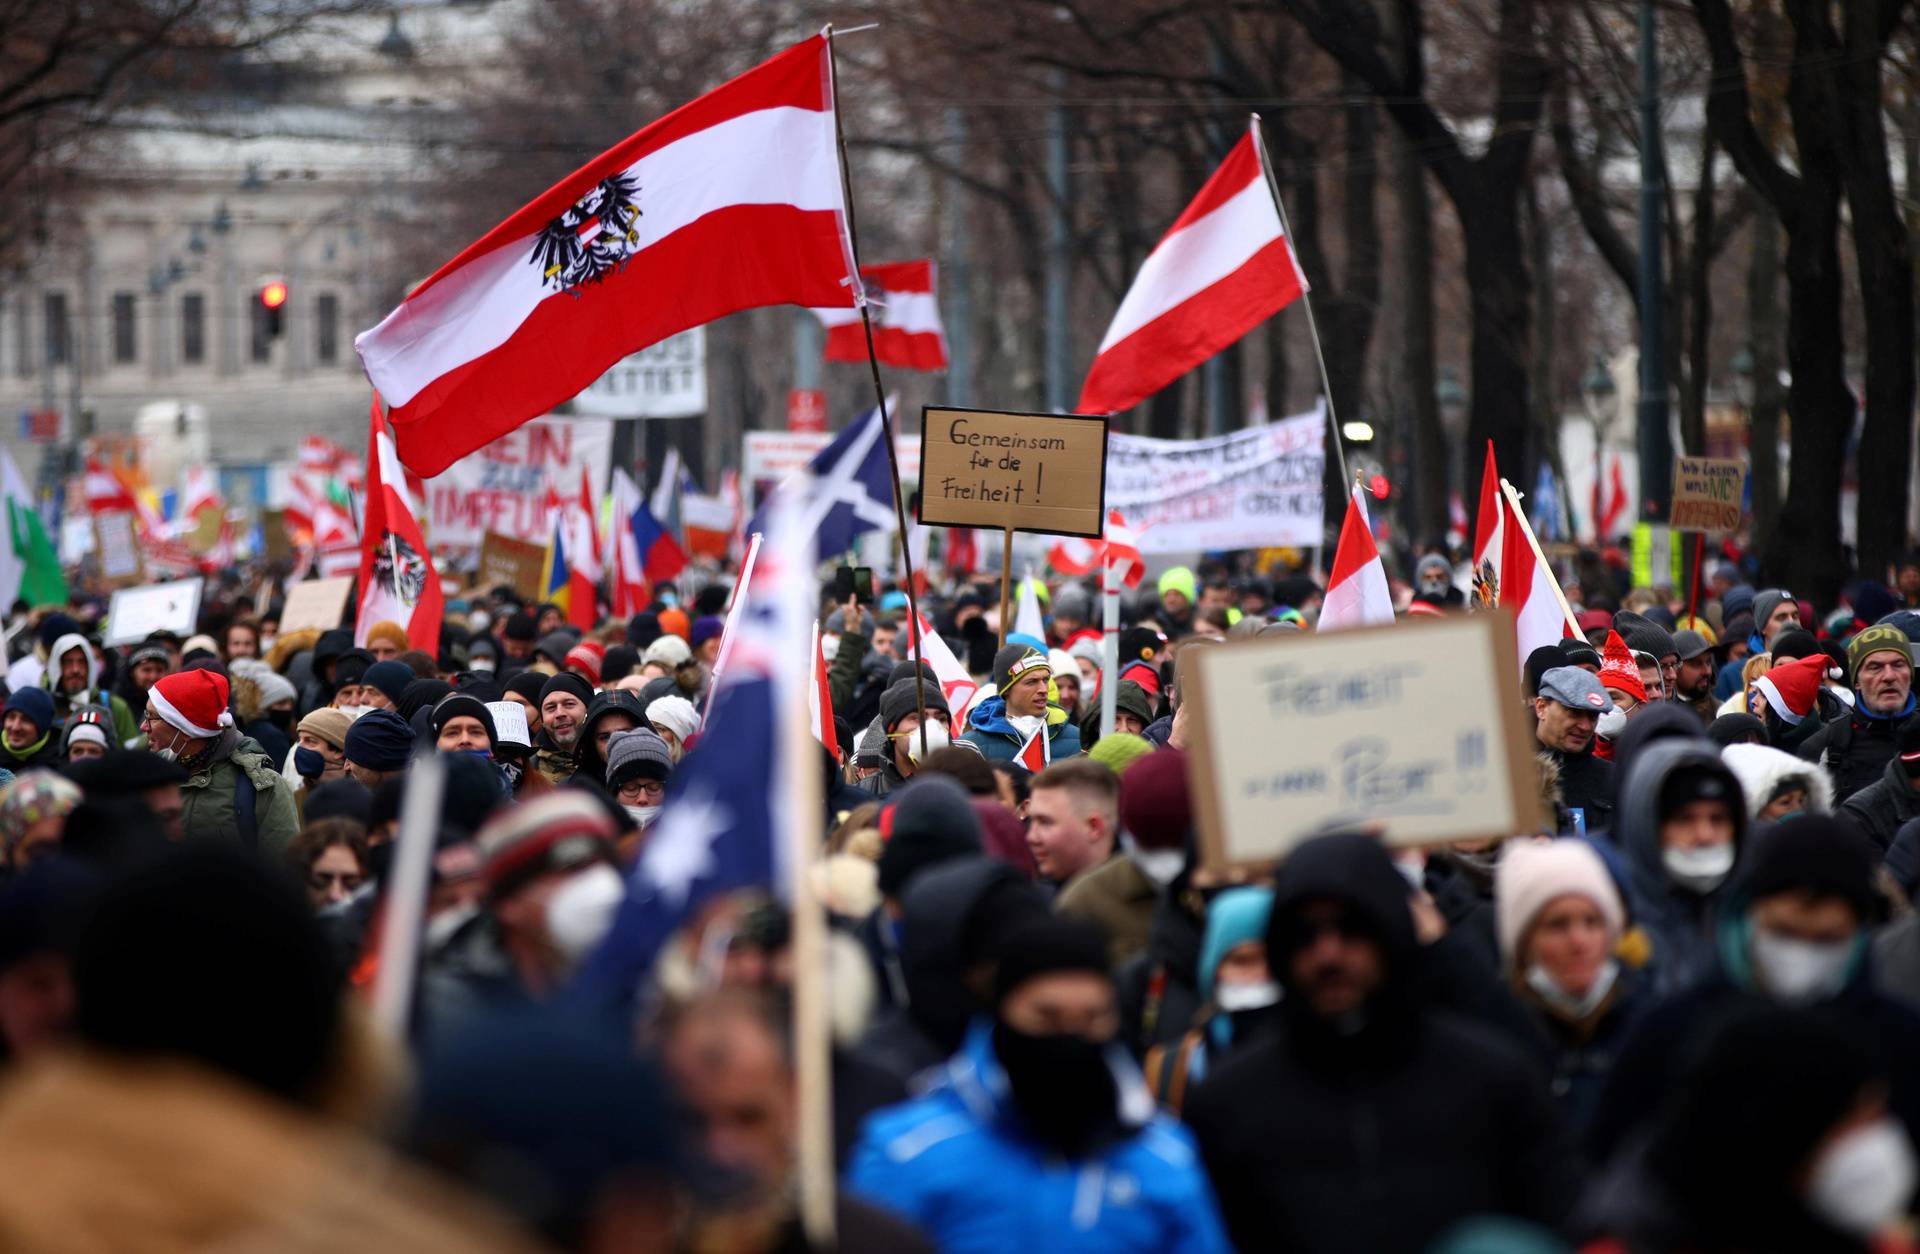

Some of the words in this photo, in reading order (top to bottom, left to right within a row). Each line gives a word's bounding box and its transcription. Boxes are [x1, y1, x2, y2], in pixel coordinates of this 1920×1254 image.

[949, 418, 1065, 450] Gemeinsam
[969, 450, 993, 470] für
[997, 450, 1022, 471] die
[941, 477, 1024, 504] Freiheit
